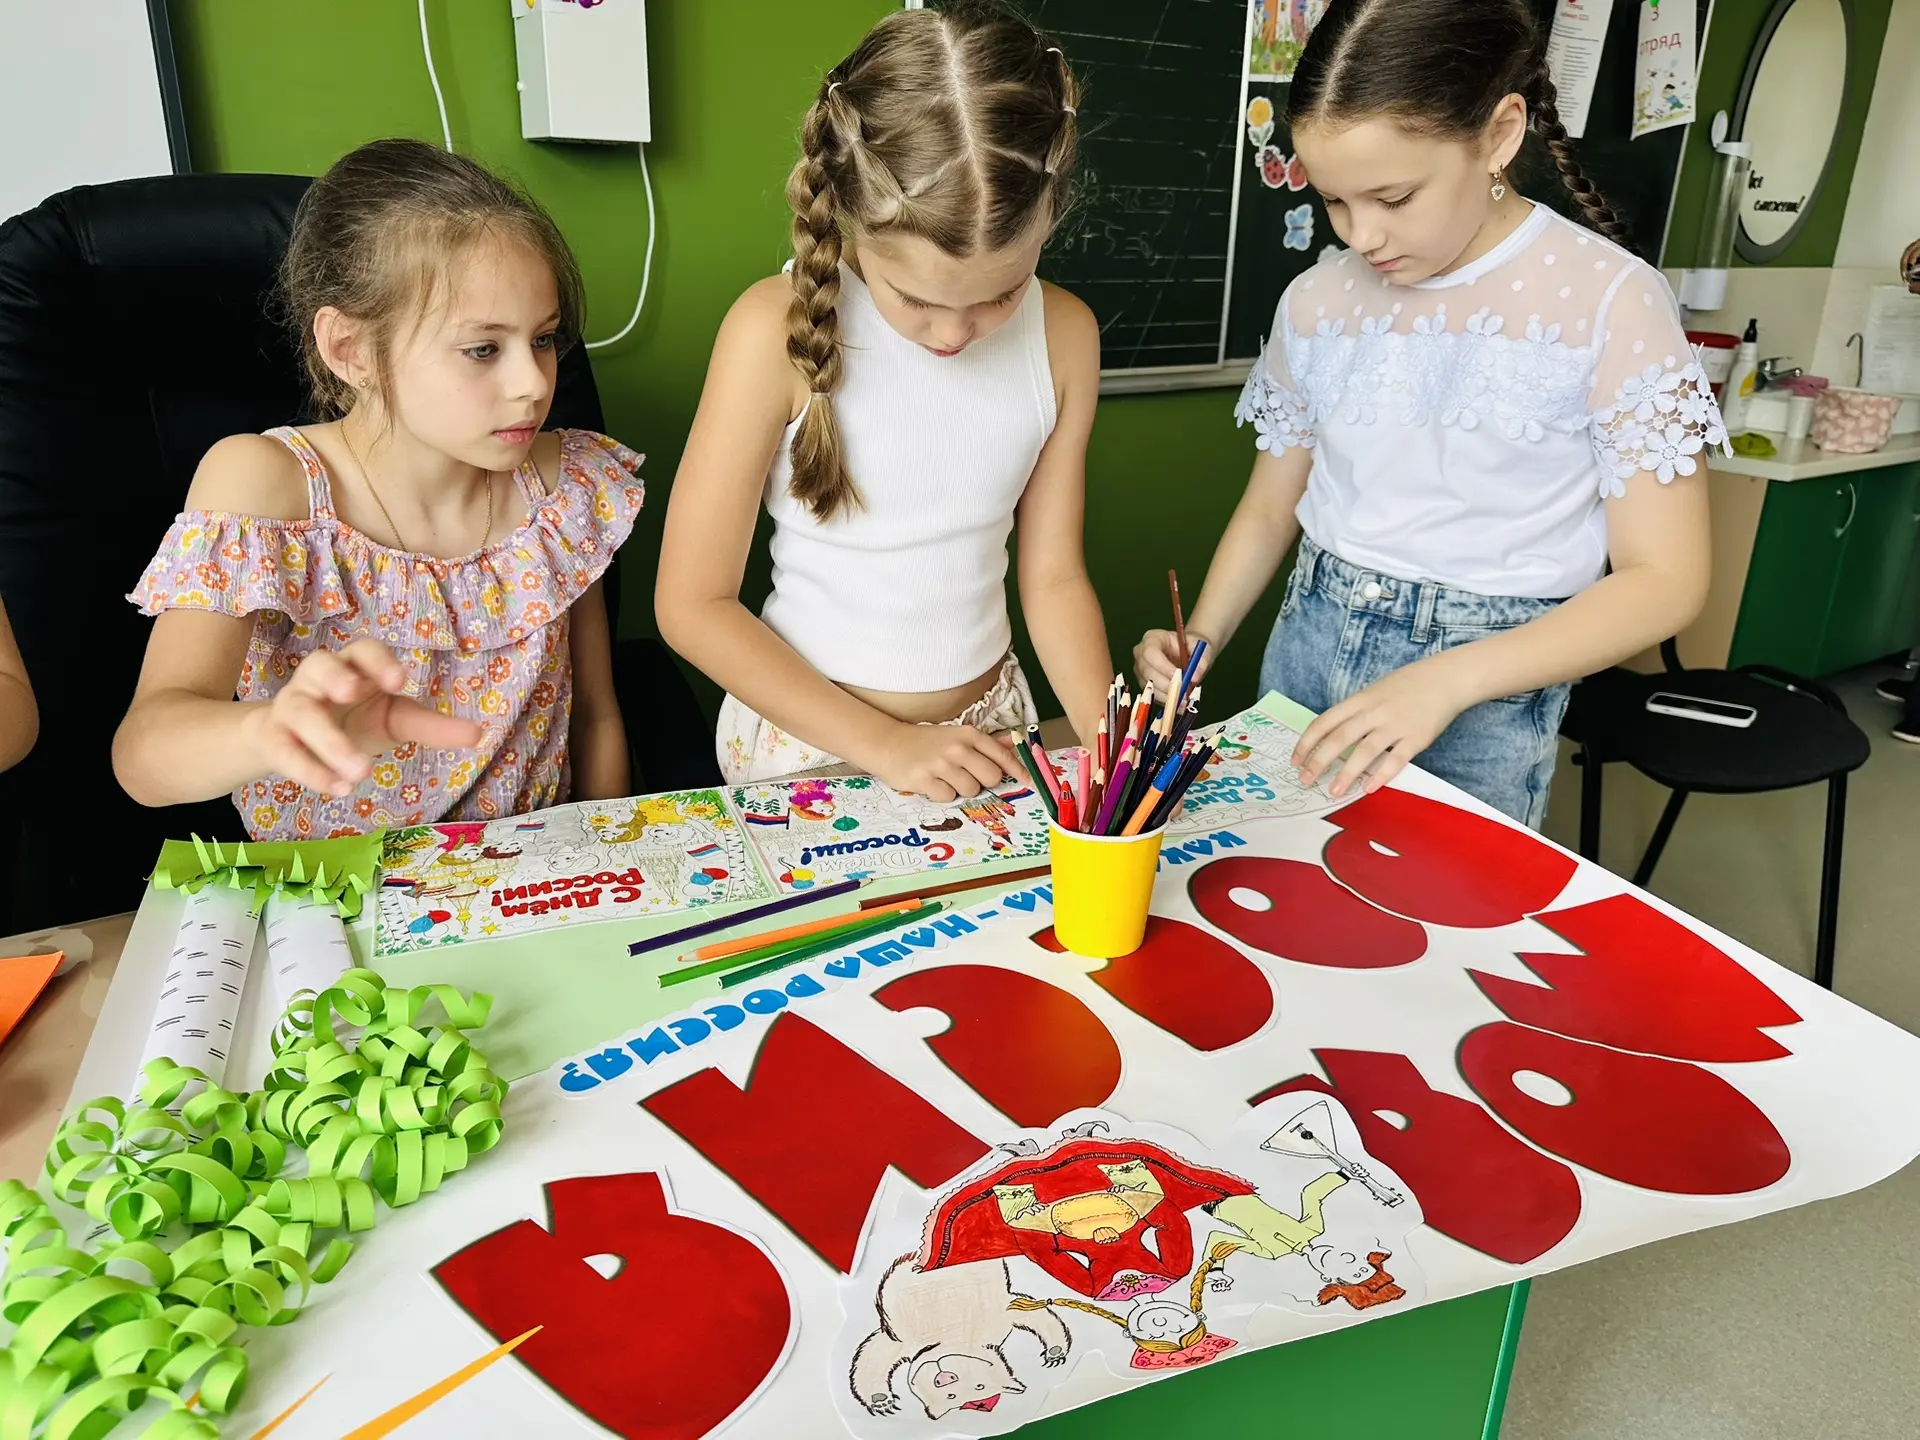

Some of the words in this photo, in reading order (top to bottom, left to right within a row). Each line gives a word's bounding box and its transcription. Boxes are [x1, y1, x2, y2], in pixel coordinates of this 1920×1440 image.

[1183, 788, 1244, 812] Днё
[800, 827, 931, 866] России!
[491, 867, 645, 907] России!
[500, 887, 602, 918] Днём
[610, 886, 642, 903] С
[823, 913, 980, 979] НАША
[559, 973, 826, 1093] РОССИЯ?
